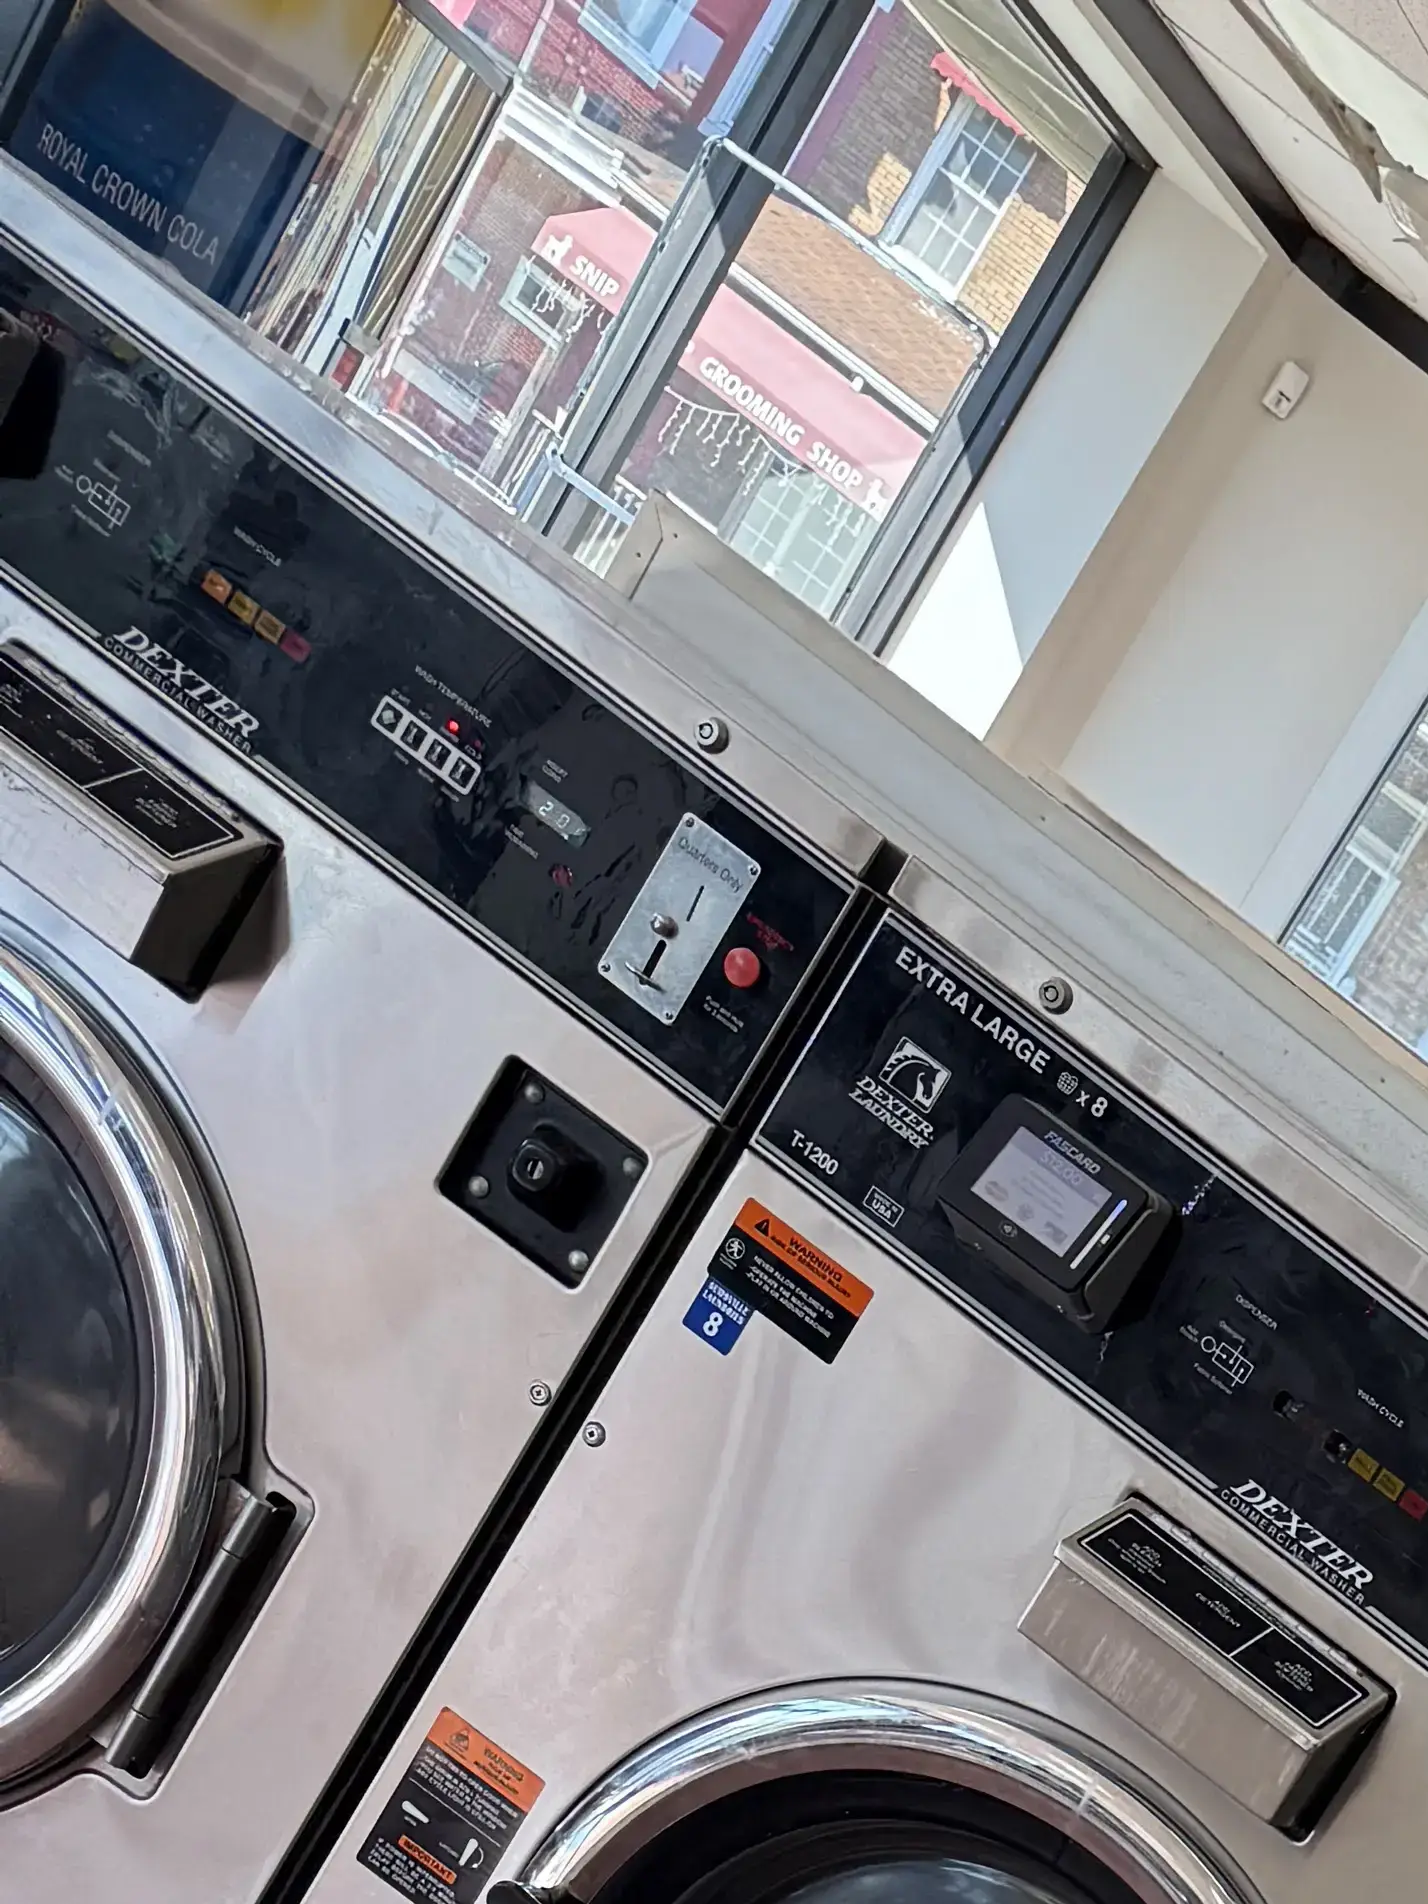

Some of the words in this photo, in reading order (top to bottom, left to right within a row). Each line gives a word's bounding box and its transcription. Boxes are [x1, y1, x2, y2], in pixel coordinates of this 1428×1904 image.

[35, 122, 96, 184] ROYAL
[87, 161, 171, 232] CROWN
[164, 212, 223, 265] COLA
[563, 249, 625, 305] SNIP
[690, 349, 814, 453] GROOMING
[799, 433, 872, 499] SHOP
[101, 635, 195, 712] COMMERCIAL
[193, 705, 255, 755] WASHER
[110, 620, 263, 739] DEXTER
[675, 835, 722, 875] Quarters
[717, 867, 746, 894] Only
[892, 945, 975, 1016] EXTRA
[968, 1003, 1052, 1075] LARGE
[1087, 1095, 1111, 1120] 8
[847, 1086, 929, 1152] LAUNDRY
[855, 1073, 936, 1138] DEXTER
[786, 1129, 840, 1176] T-1200
[1043, 1128, 1102, 1176] FASCARD
[786, 1236, 845, 1283] WARNING
[699, 1309, 727, 1339] 8
[1218, 1489, 1308, 1562] COMMERCIAL
[1307, 1557, 1366, 1606] WASHER
[1228, 1472, 1376, 1591] DEXTER
